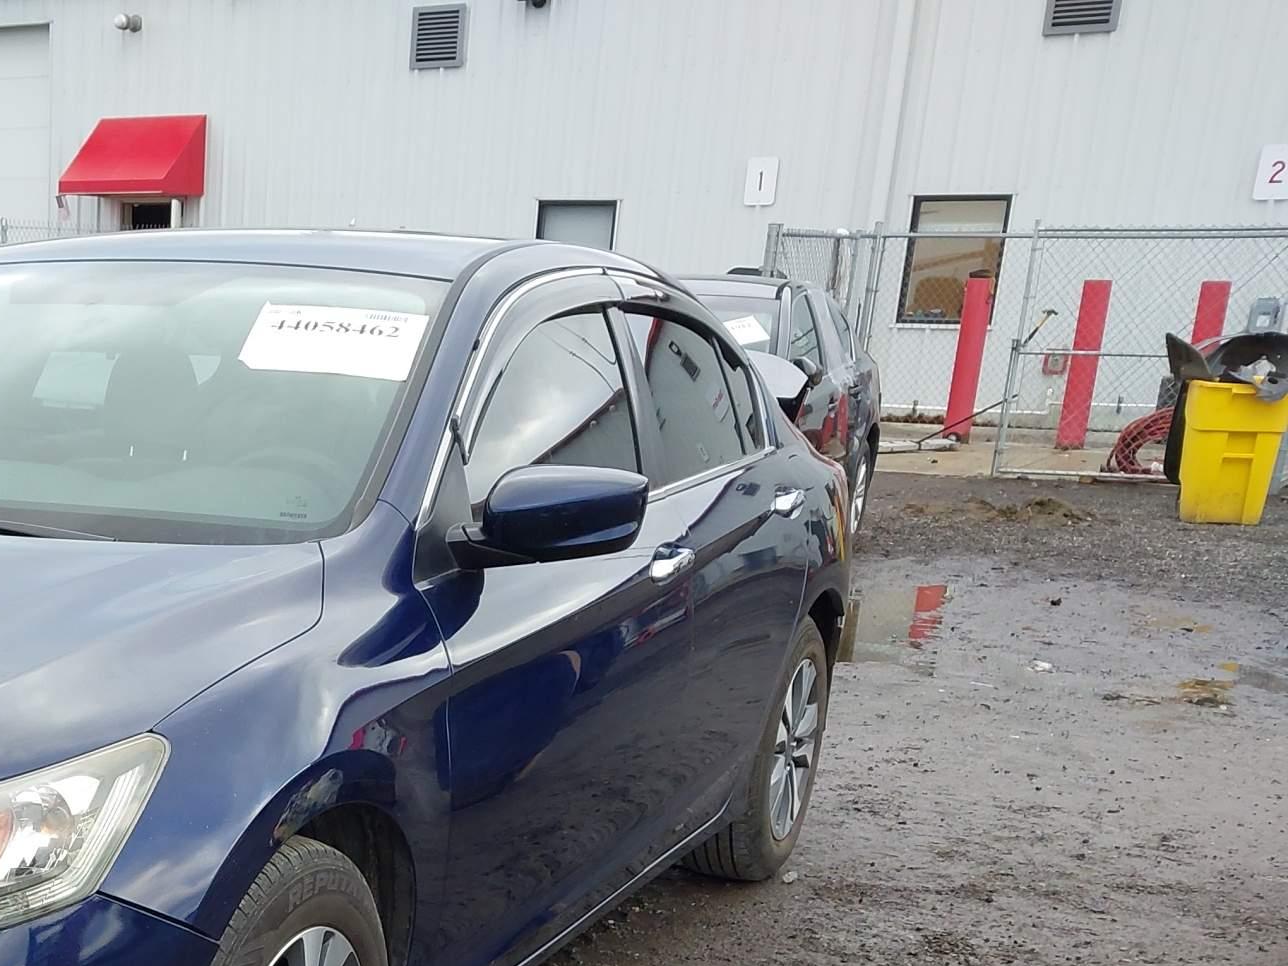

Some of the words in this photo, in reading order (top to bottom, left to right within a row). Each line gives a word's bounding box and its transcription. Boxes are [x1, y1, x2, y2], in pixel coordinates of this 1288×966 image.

[758, 170, 764, 192] 1
[1268, 160, 1286, 184] 2
[270, 317, 401, 339] 44058462
